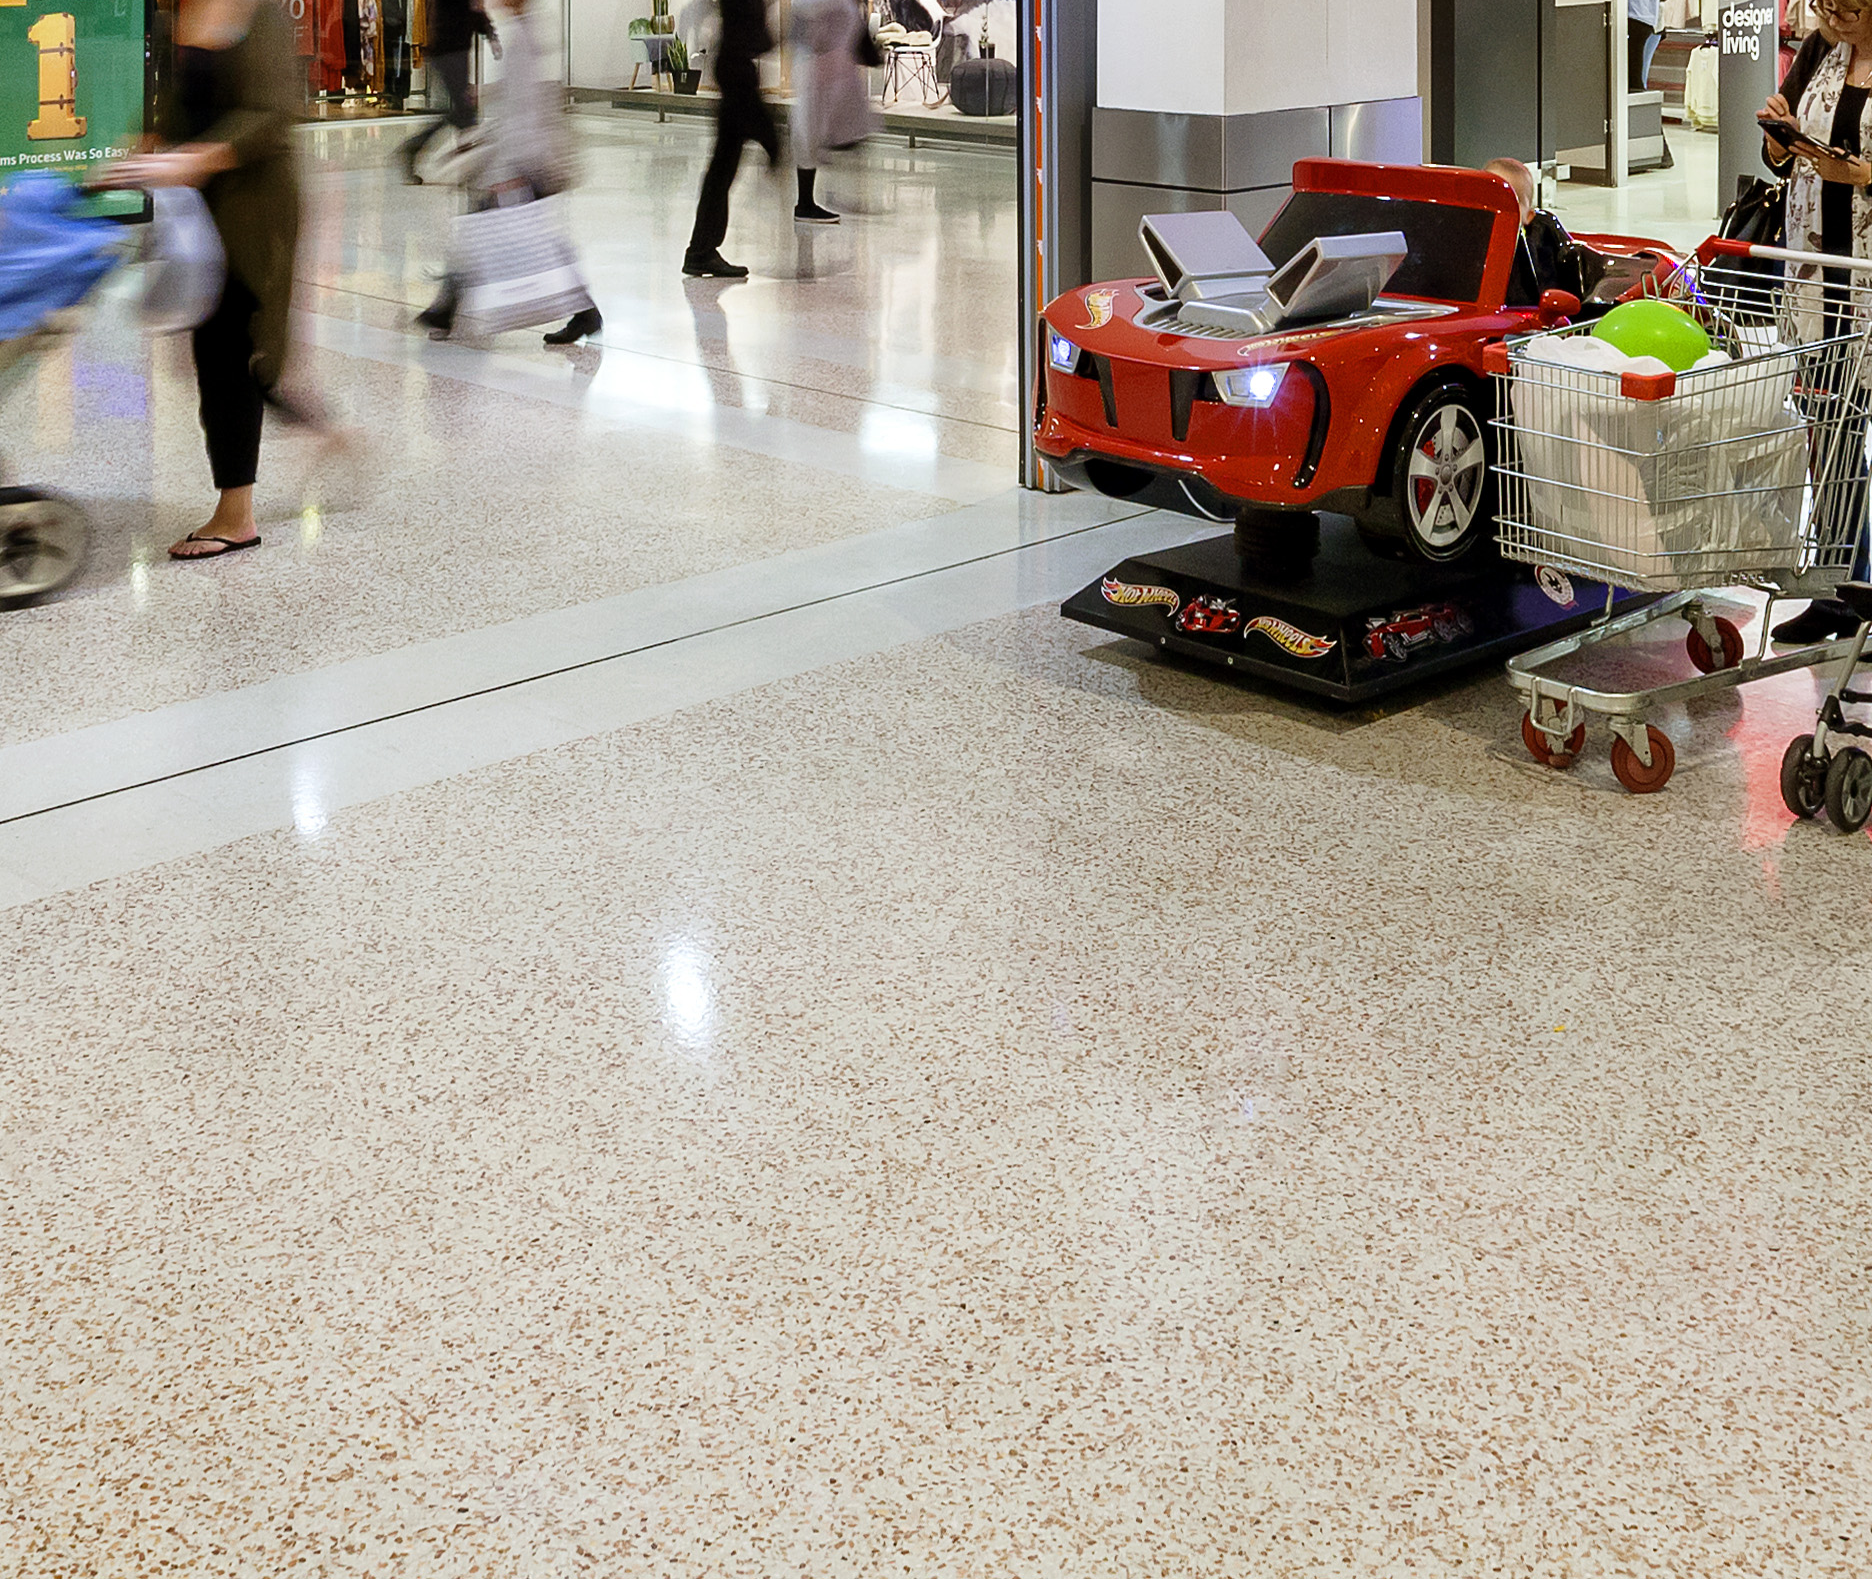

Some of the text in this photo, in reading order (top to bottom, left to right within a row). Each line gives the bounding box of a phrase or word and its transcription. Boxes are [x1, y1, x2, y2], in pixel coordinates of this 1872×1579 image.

[1722, 2, 1774, 34] designer
[1722, 29, 1760, 61] living
[19, 151, 61, 165] Process
[64, 149, 87, 161] Was
[89, 147, 103, 160] So
